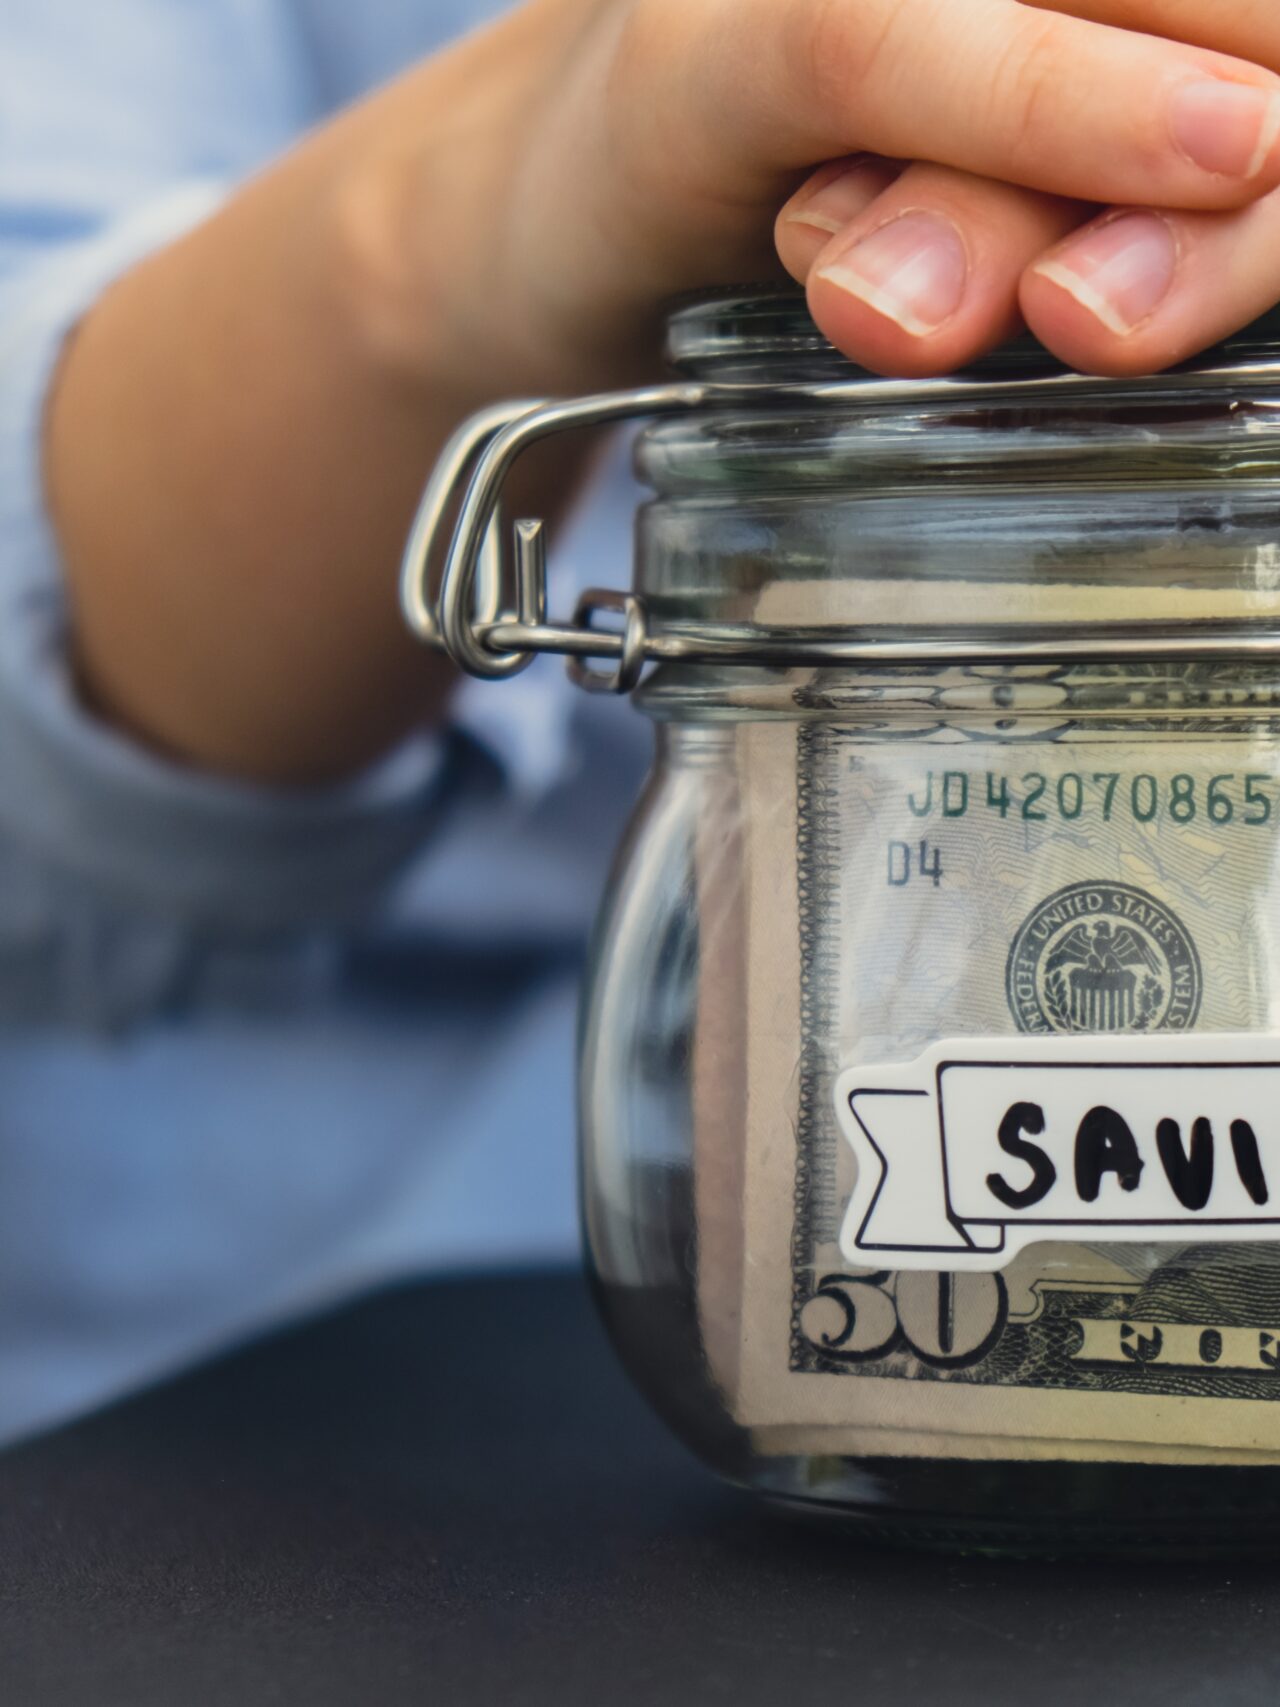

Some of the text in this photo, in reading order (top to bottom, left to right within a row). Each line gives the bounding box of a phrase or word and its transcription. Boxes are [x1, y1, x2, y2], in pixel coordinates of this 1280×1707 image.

[886, 839, 943, 887] D4
[1031, 892, 1177, 945] UNITED STATES
[1016, 958, 1051, 1033] FEDERA
[1165, 963, 1192, 1030] STEM
[798, 1269, 1009, 1370] 50
